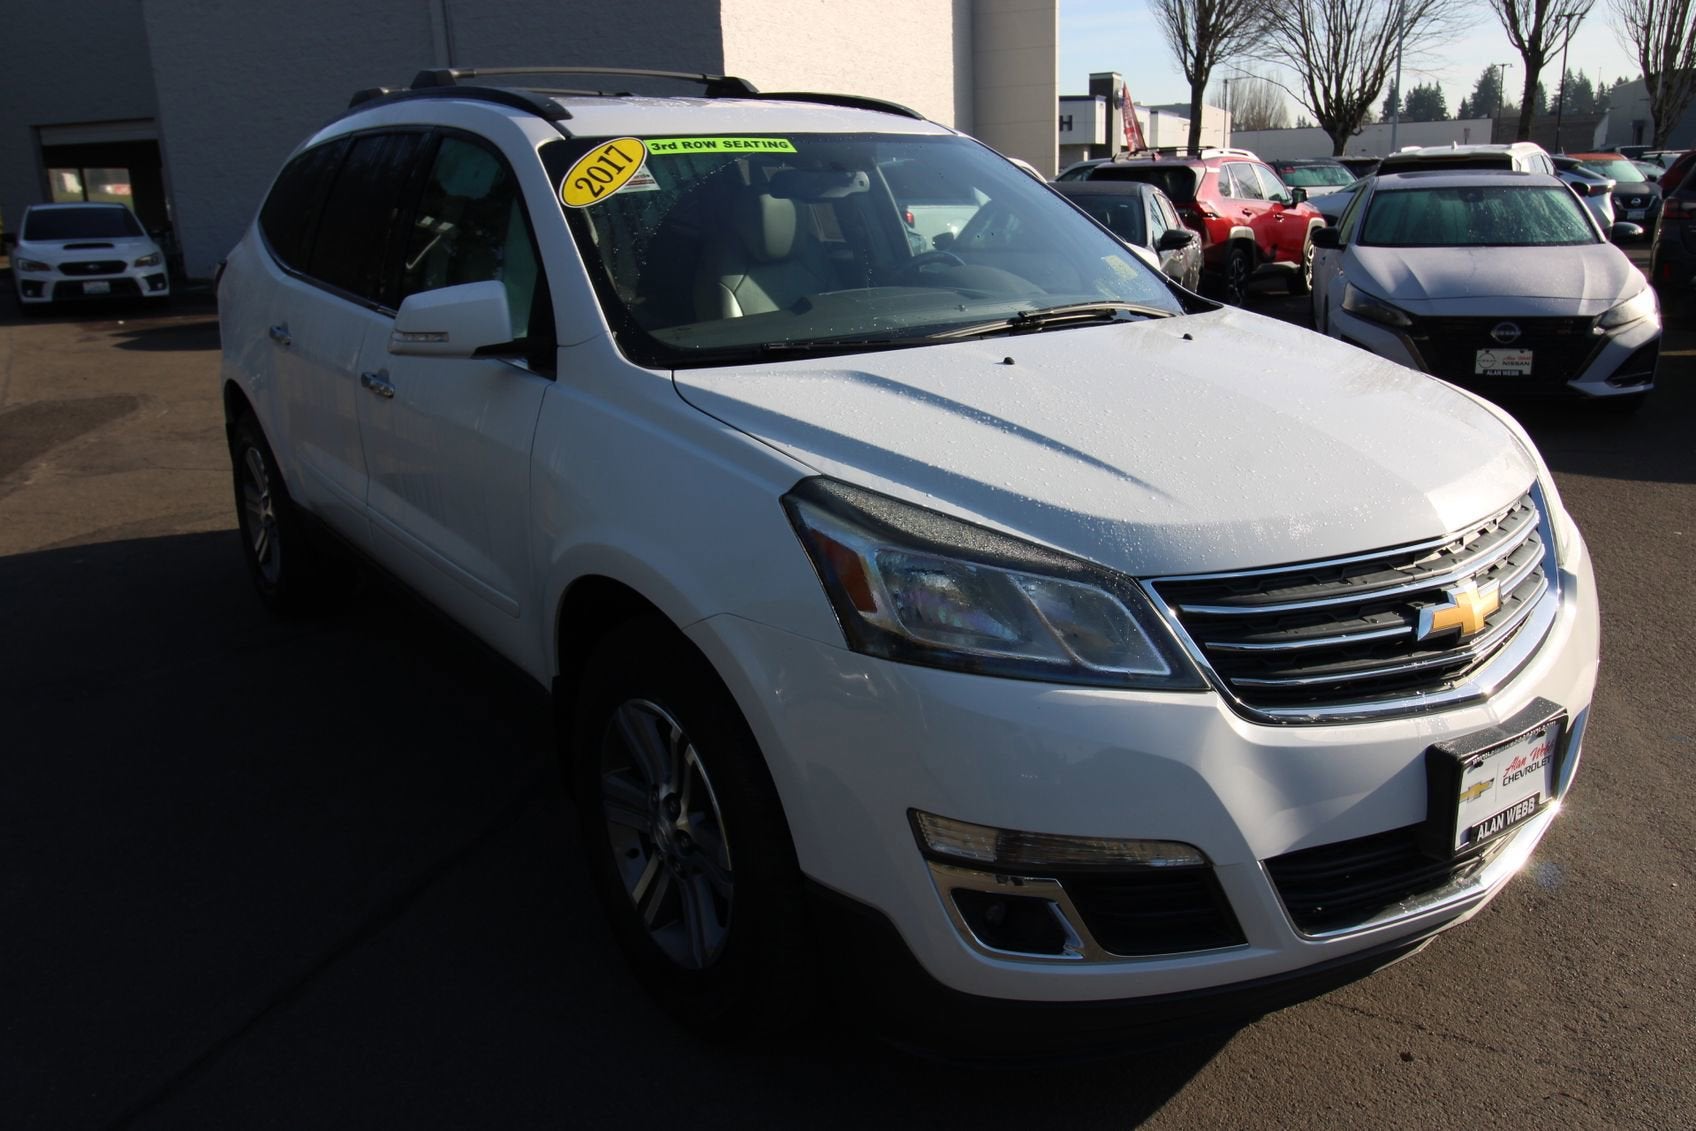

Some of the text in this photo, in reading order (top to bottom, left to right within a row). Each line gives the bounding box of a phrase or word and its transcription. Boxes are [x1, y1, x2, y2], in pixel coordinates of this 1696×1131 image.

[651, 140, 789, 150] 3rd ROW SEATING
[575, 145, 633, 198] 2017
[1502, 756, 1551, 787] CHEVROLET
[1503, 756, 1527, 778] Alan
[1477, 797, 1535, 842] ALAN WEBB
